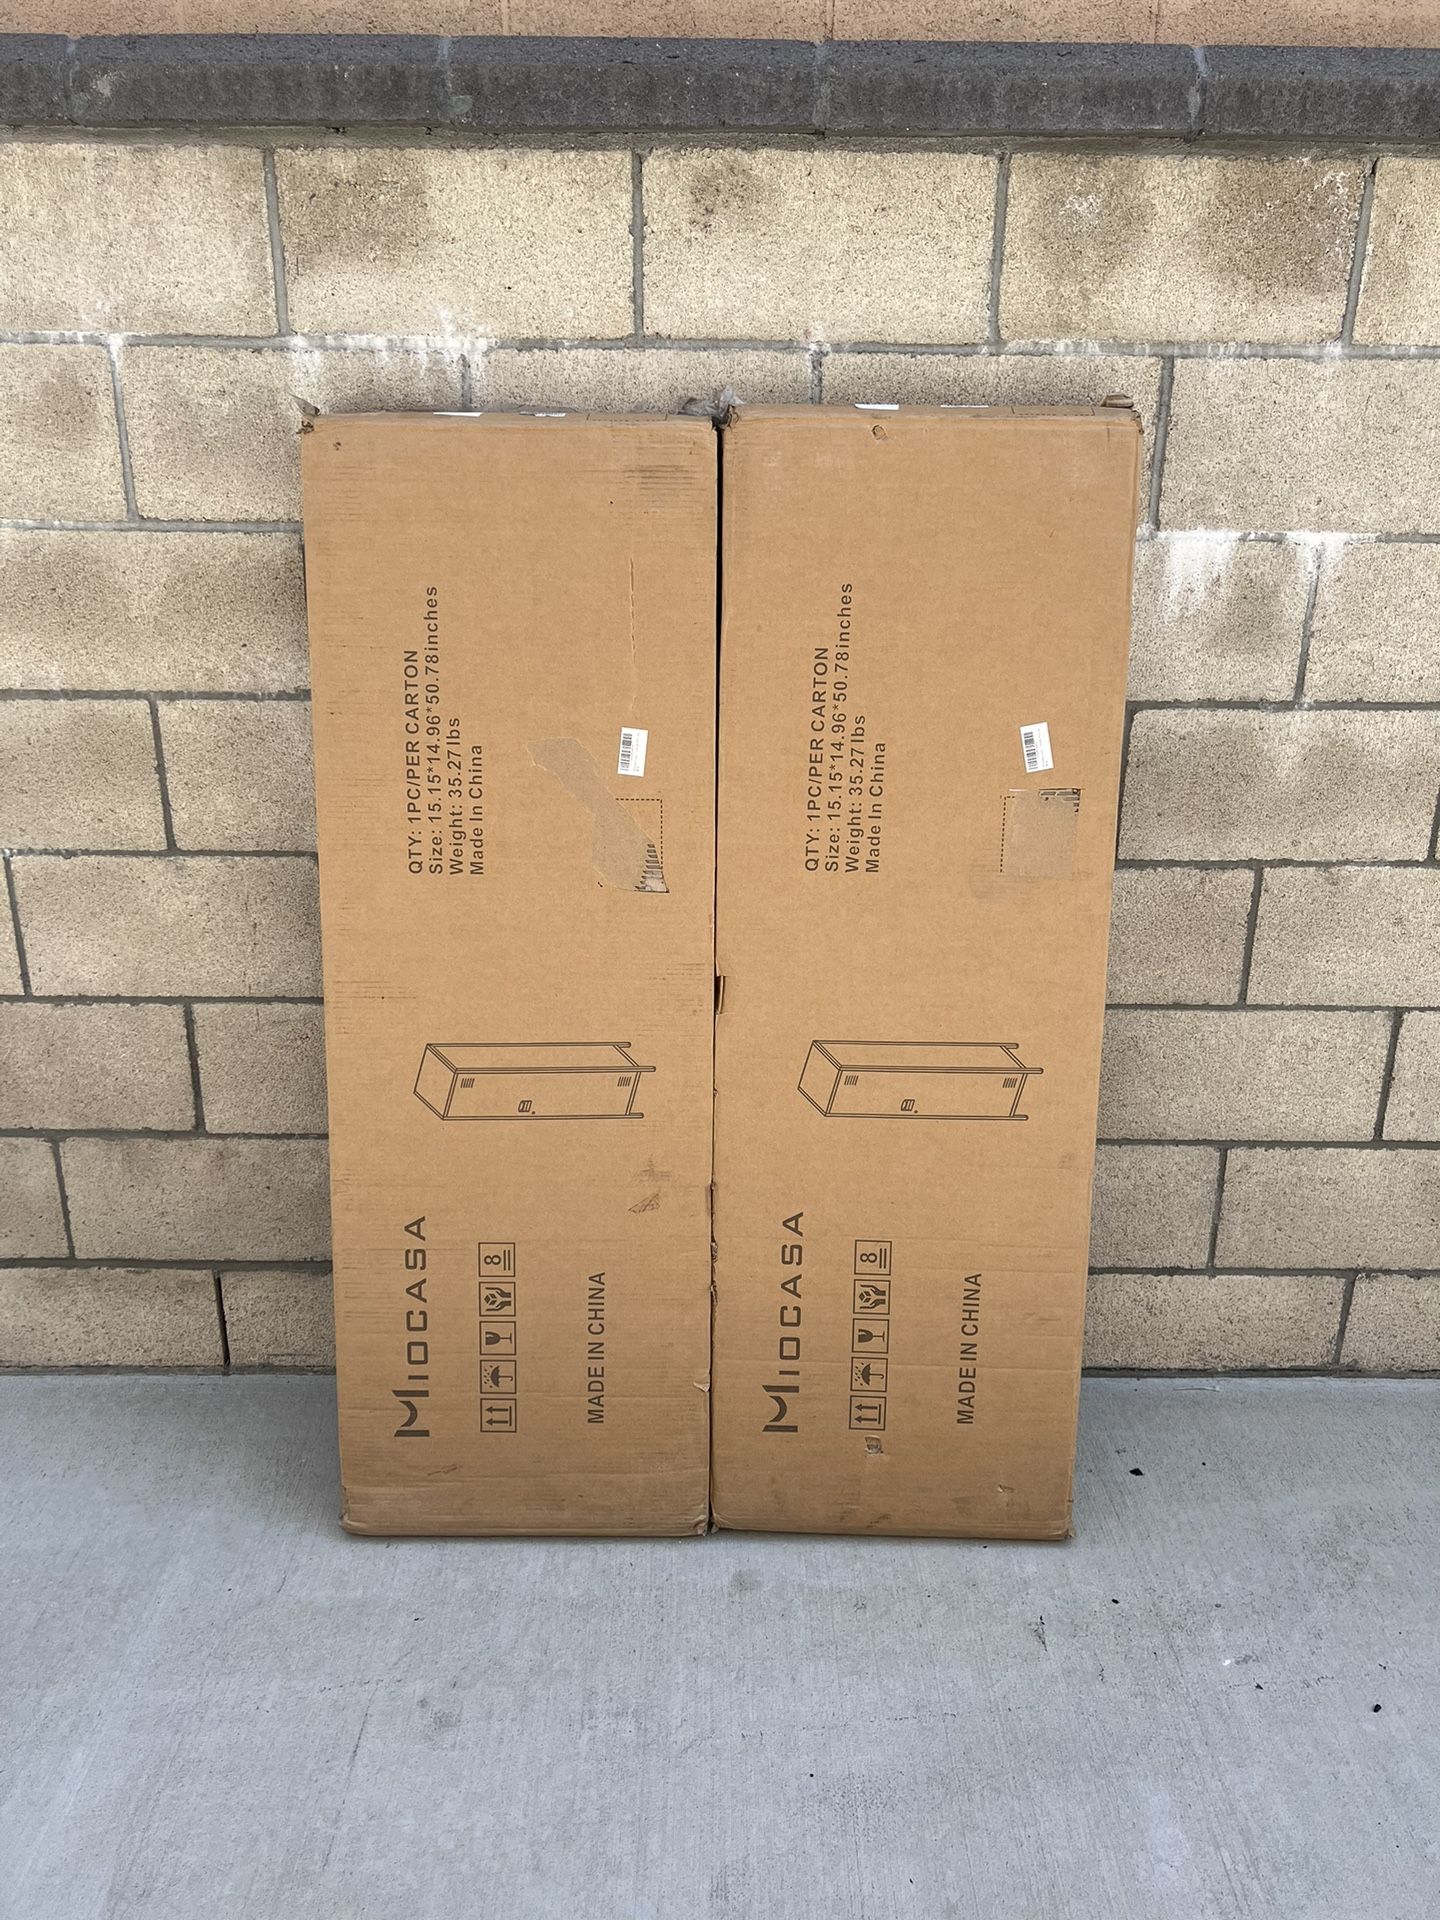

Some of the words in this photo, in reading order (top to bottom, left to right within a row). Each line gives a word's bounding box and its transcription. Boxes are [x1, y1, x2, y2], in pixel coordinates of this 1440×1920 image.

[403, 650, 420, 735] CARTON
[811, 647, 829, 732] CARTON
[405, 740, 423, 824] 1PC/PER
[467, 745, 484, 800] China
[807, 738, 824, 822] 1PC/PER
[868, 743, 886, 797] China
[468, 805, 484, 822] In
[867, 803, 883, 820] In
[408, 831, 424, 874] QTY:
[428, 830, 444, 875] Size:
[448, 805, 466, 876] Weight:
[469, 827, 485, 875] Made
[805, 828, 820, 872] QTY:
[825, 827, 841, 872] Size:
[844, 802, 864, 873] Weight:
[865, 825, 882, 873] Made
[483, 1254, 502, 1266] 8
[859, 1252, 878, 1264] 8
[587, 1271, 606, 1336] CHINA
[960, 1273, 982, 1337] CHINA
[587, 1342, 605, 1360] IN
[959, 1342, 978, 1361] IN
[587, 1366, 605, 1424] MADE
[956, 1367, 977, 1425] MADE
